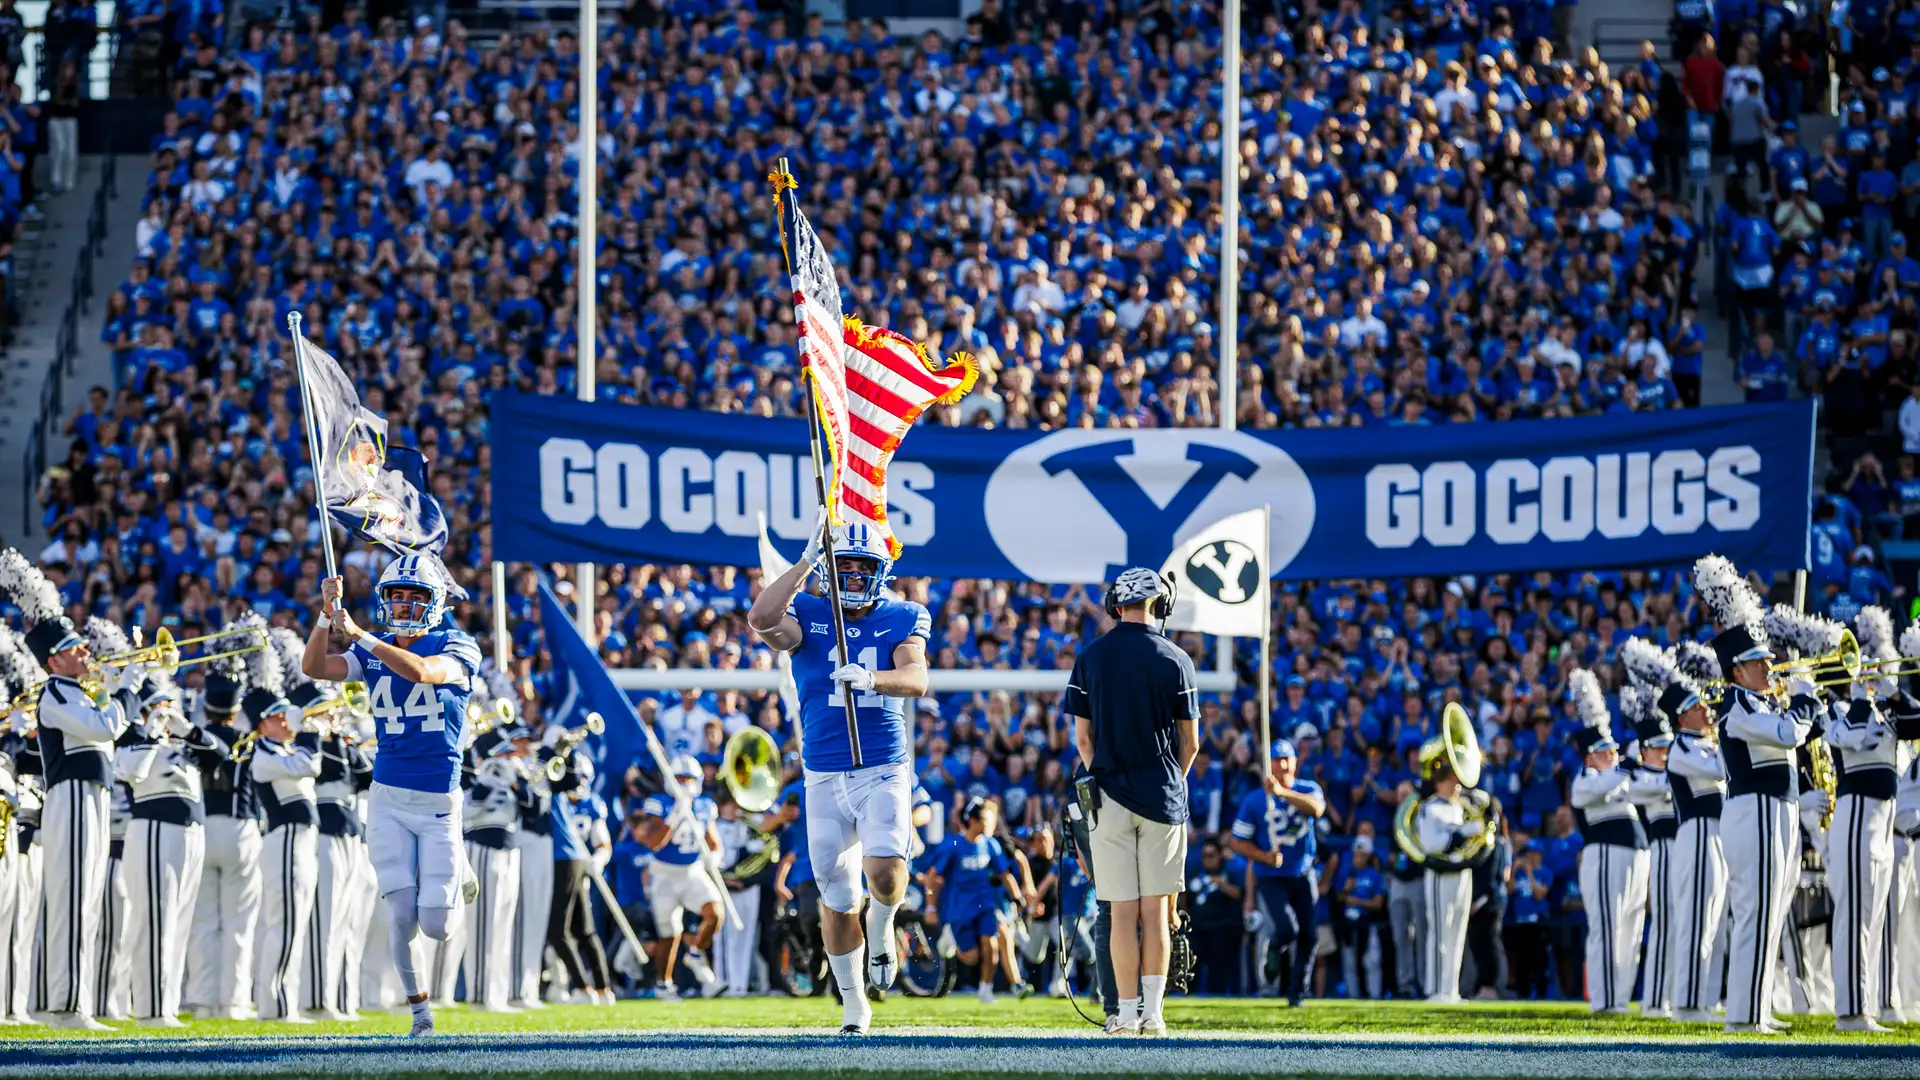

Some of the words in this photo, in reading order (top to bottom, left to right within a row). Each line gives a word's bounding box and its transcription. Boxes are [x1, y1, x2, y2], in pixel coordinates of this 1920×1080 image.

[540, 437, 650, 530] GO
[658, 446, 936, 547] COUS
[1040, 438, 1261, 583] Y
[1365, 463, 1476, 548] GO
[1485, 445, 1762, 544] COUGS
[1125, 582, 1137, 592] Y
[1190, 541, 1255, 601] Y
[849, 628, 858, 636] Y
[370, 675, 445, 735] 44
